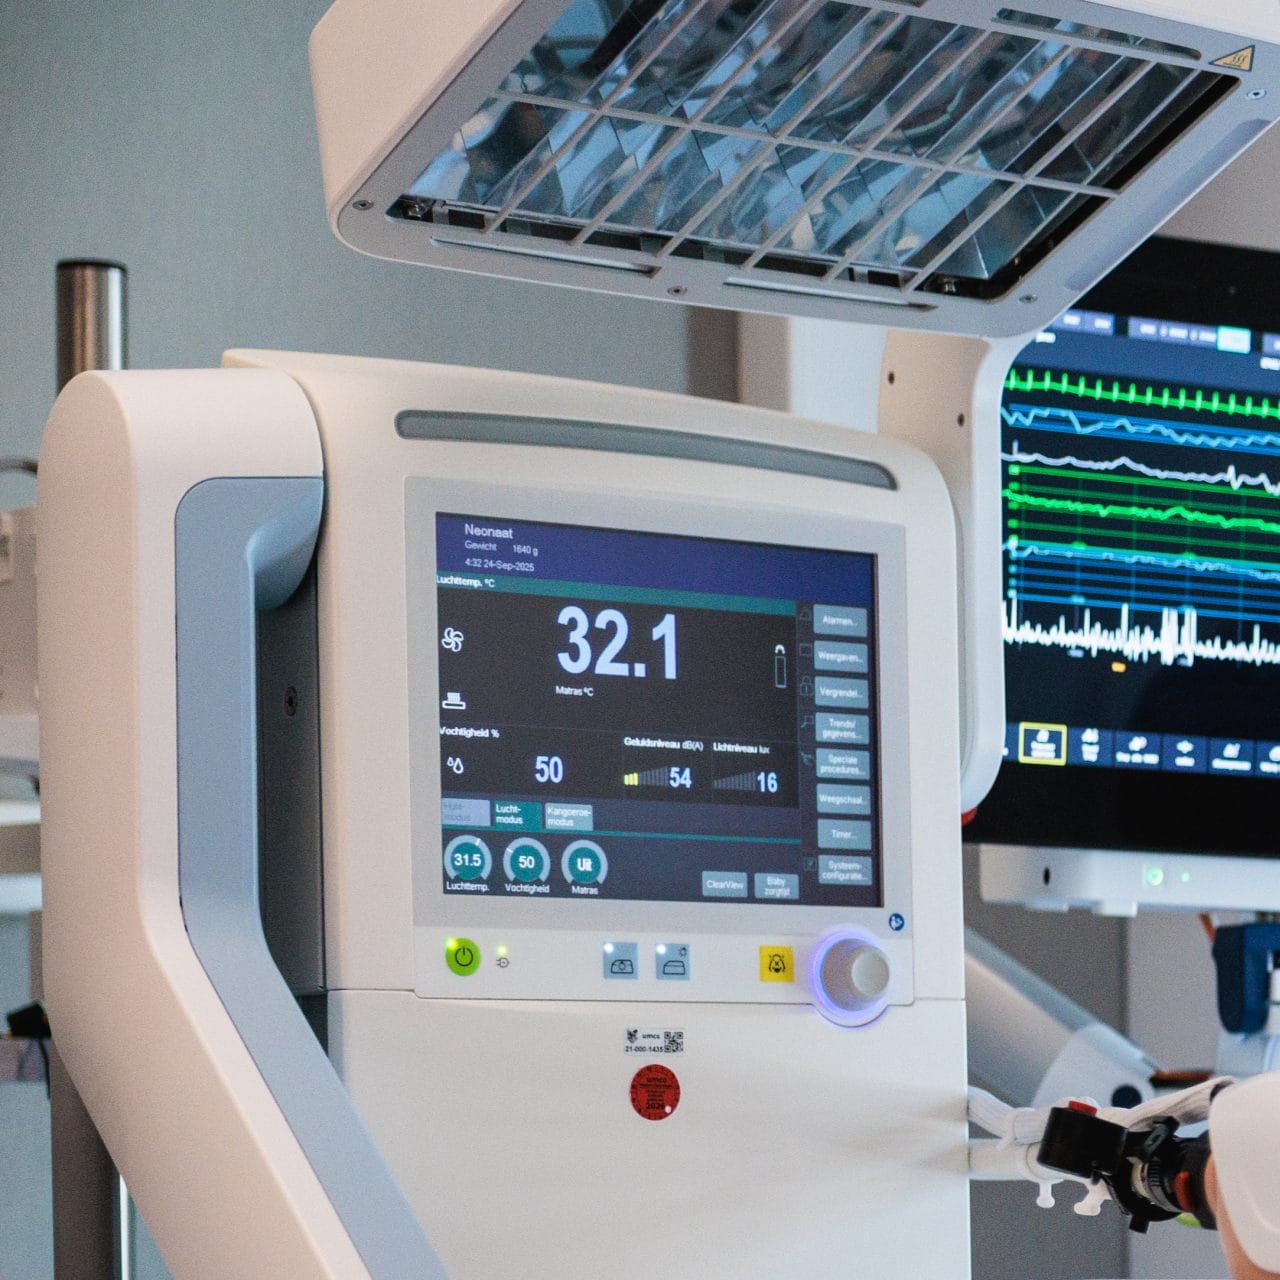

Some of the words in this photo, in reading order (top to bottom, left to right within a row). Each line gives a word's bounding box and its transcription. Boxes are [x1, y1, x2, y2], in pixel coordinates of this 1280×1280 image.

[464, 524, 514, 539] Neonaat
[464, 540, 497, 551] Gewicht
[533, 548, 538, 556] g
[436, 575, 482, 588] Luchttemp.
[557, 606, 677, 679] 32.1
[556, 686, 582, 697] Matras
[440, 726, 489, 738] Vochtigheid
[491, 729, 500, 738] %
[713, 742, 758, 754] Lichtniveau
[758, 745, 770, 754] lux
[534, 756, 564, 784] 50
[670, 766, 692, 788] 54
[757, 772, 778, 792] 16
[496, 804, 521, 814] Lucht-
[496, 815, 524, 825] modus
[548, 818, 574, 827] modus
[454, 854, 482, 867] 31.5
[518, 856, 535, 868] 50
[576, 858, 592, 872] Uit
[446, 882, 490, 892] Luchttemp.
[505, 883, 550, 894] Vochtigheid
[572, 886, 598, 895] Matras
